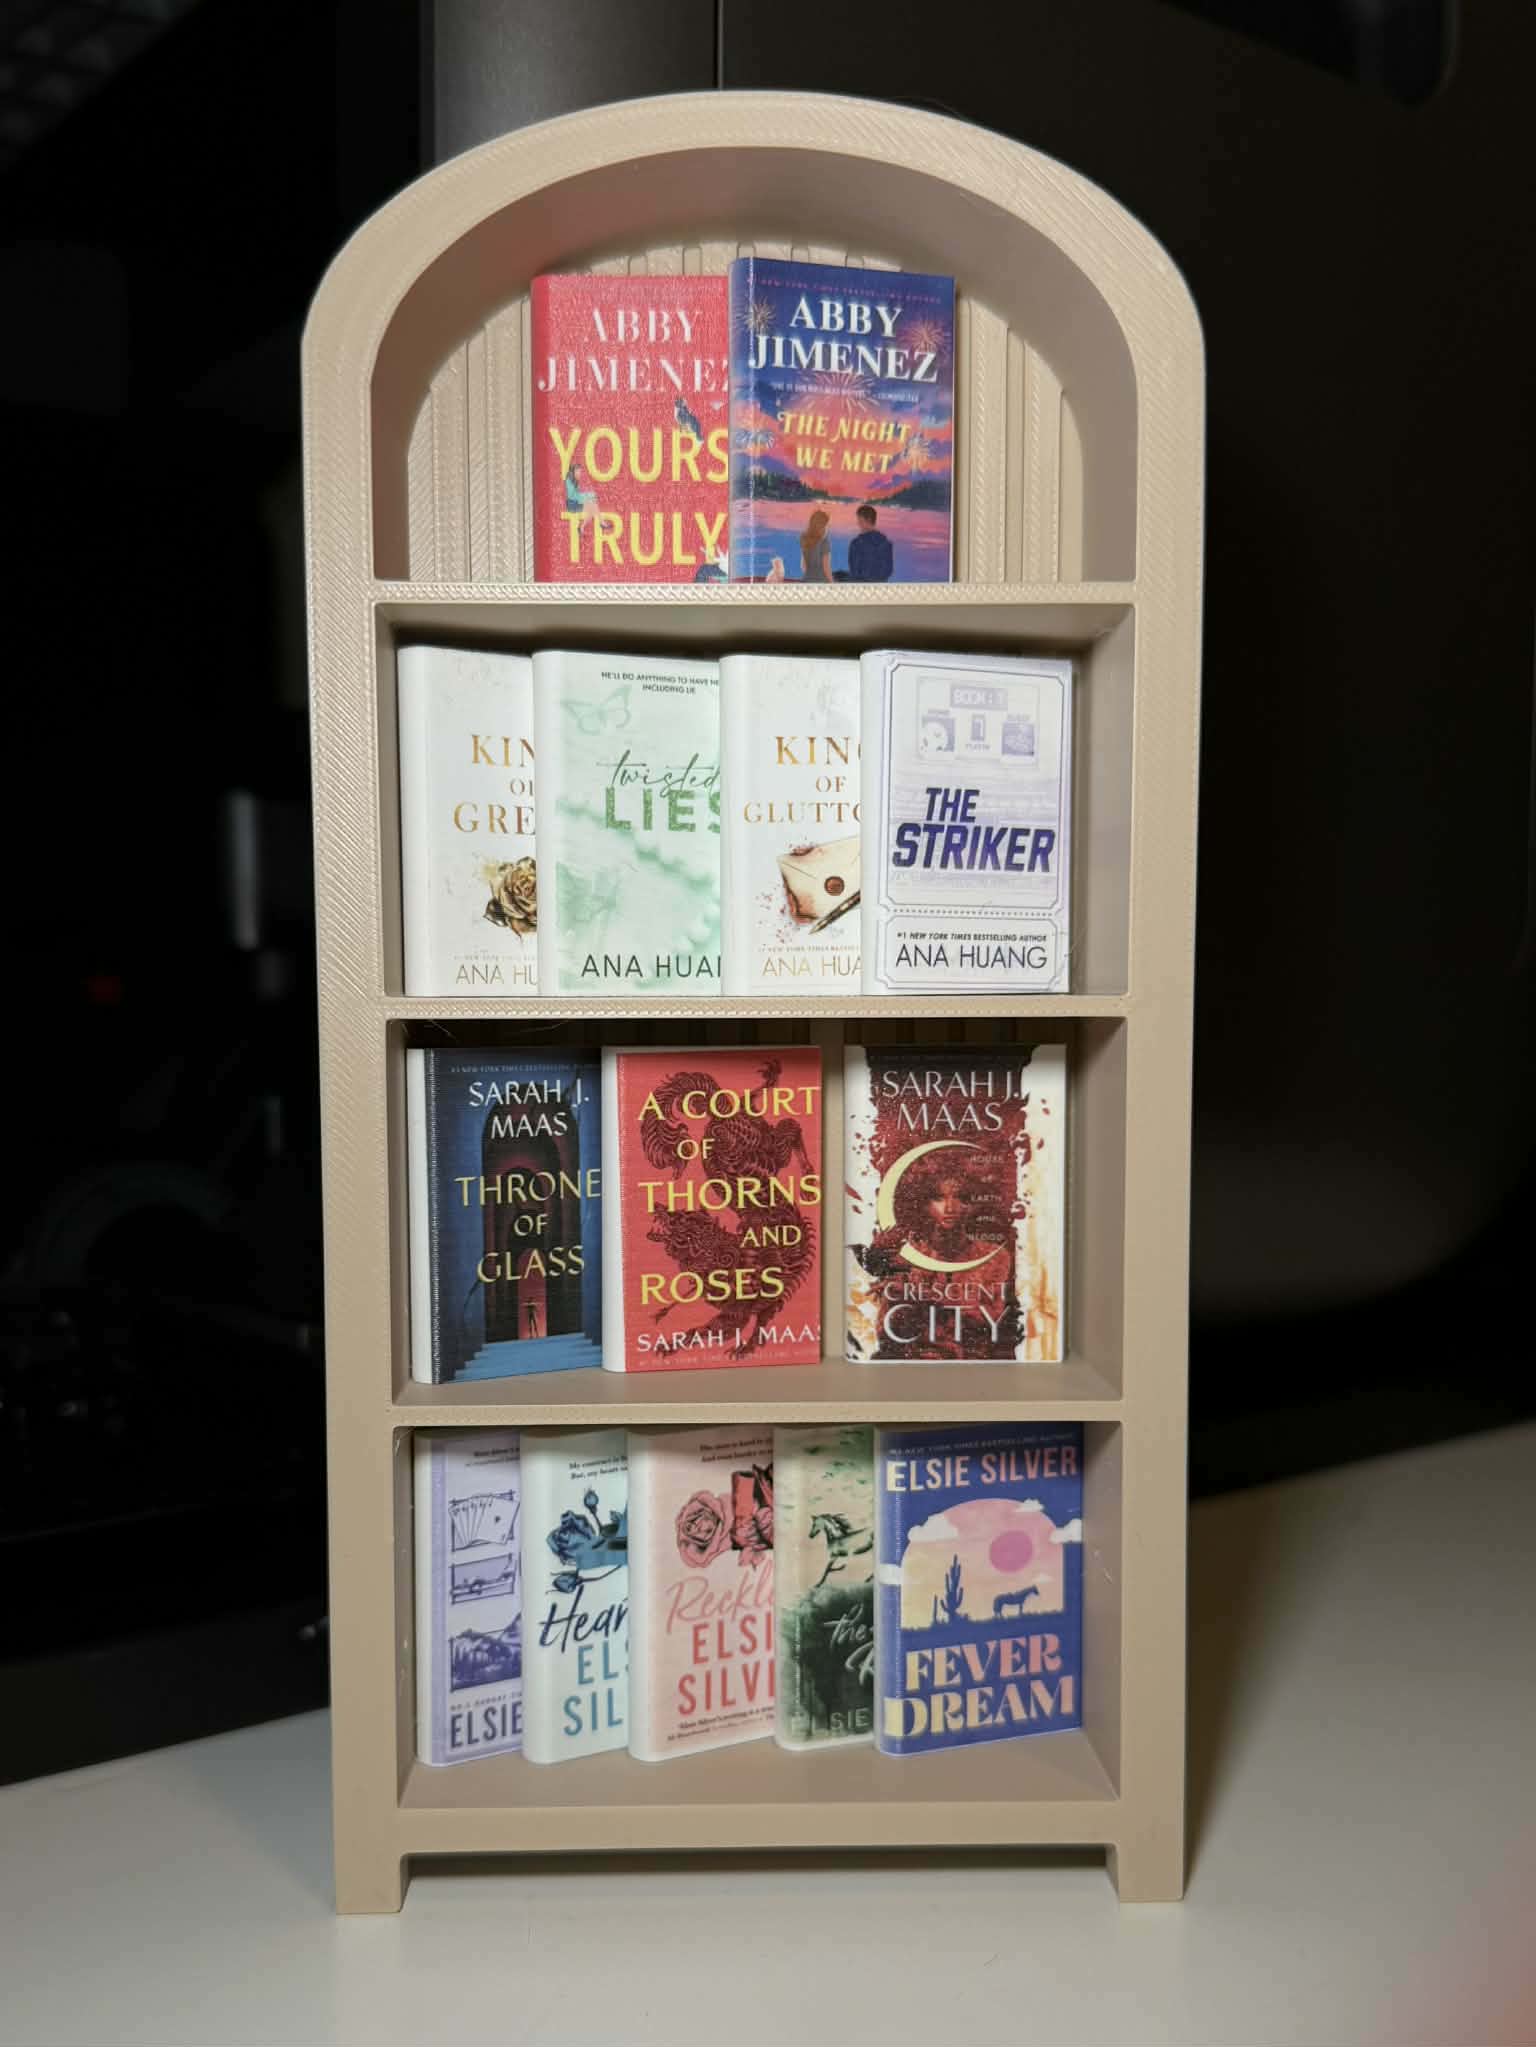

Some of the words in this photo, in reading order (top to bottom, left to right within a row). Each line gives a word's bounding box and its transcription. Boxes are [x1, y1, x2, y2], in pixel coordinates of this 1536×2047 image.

[584, 308, 700, 343] ABBY
[789, 297, 901, 337] ABBY
[748, 334, 938, 383] JIMENEZ
[777, 411, 833, 437] THE
[831, 416, 911, 443] NIGHT
[549, 427, 728, 482] YOURS
[796, 447, 833, 470] WE
[840, 451, 894, 474] MET
[561, 511, 726, 566] TRULY
[622, 672, 634, 681] DO
[636, 674, 676, 684] ANYTHING
[678, 676, 688, 685] TO
[689, 678, 708, 686] HAVE
[642, 684, 684, 694] INCLUDING
[775, 736, 861, 766] KIN
[816, 775, 847, 793] OF
[925, 787, 980, 823] THE
[892, 822, 1056, 873] STRIKER
[910, 932, 926, 940] NEW
[951, 933, 972, 941] TIMES
[973, 933, 1017, 942] BESTSELLING
[1019, 934, 1047, 943] AUTHOR
[581, 955, 643, 978] ANA
[656, 956, 720, 978] HUA
[762, 956, 812, 976] ANA
[896, 943, 949, 968] ANA
[959, 944, 1048, 969] HUANG
[455, 963, 505, 985] ANA
[469, 1079, 561, 1107] SARAH
[571, 1078, 590, 1108] J.
[882, 1071, 992, 1098] SARAH
[1003, 1071, 1020, 1103] J.
[637, 1092, 666, 1121] A
[682, 1086, 820, 1120] COURT
[896, 1103, 1003, 1131] MAAS
[490, 1112, 568, 1140] MAAS
[677, 1138, 715, 1160] OF
[454, 1167, 601, 1207] THRONE
[638, 1174, 821, 1213] THORNS
[514, 1213, 549, 1237] OF
[740, 1225, 801, 1248] AND
[476, 1245, 585, 1284] GLASS
[640, 1267, 784, 1305] ROSES
[883, 1281, 1007, 1302] CRESCENT
[883, 1303, 1010, 1343] CITY
[637, 1329, 724, 1352] SARAH
[735, 1327, 748, 1349] J.
[886, 1456, 971, 1492] ELSIE
[980, 1446, 1077, 1485] SILVER
[577, 1640, 627, 1686] EL
[906, 1633, 1062, 1692] FEVER
[883, 1675, 1075, 1738] DREAM
[451, 1701, 522, 1749] ELSIE
